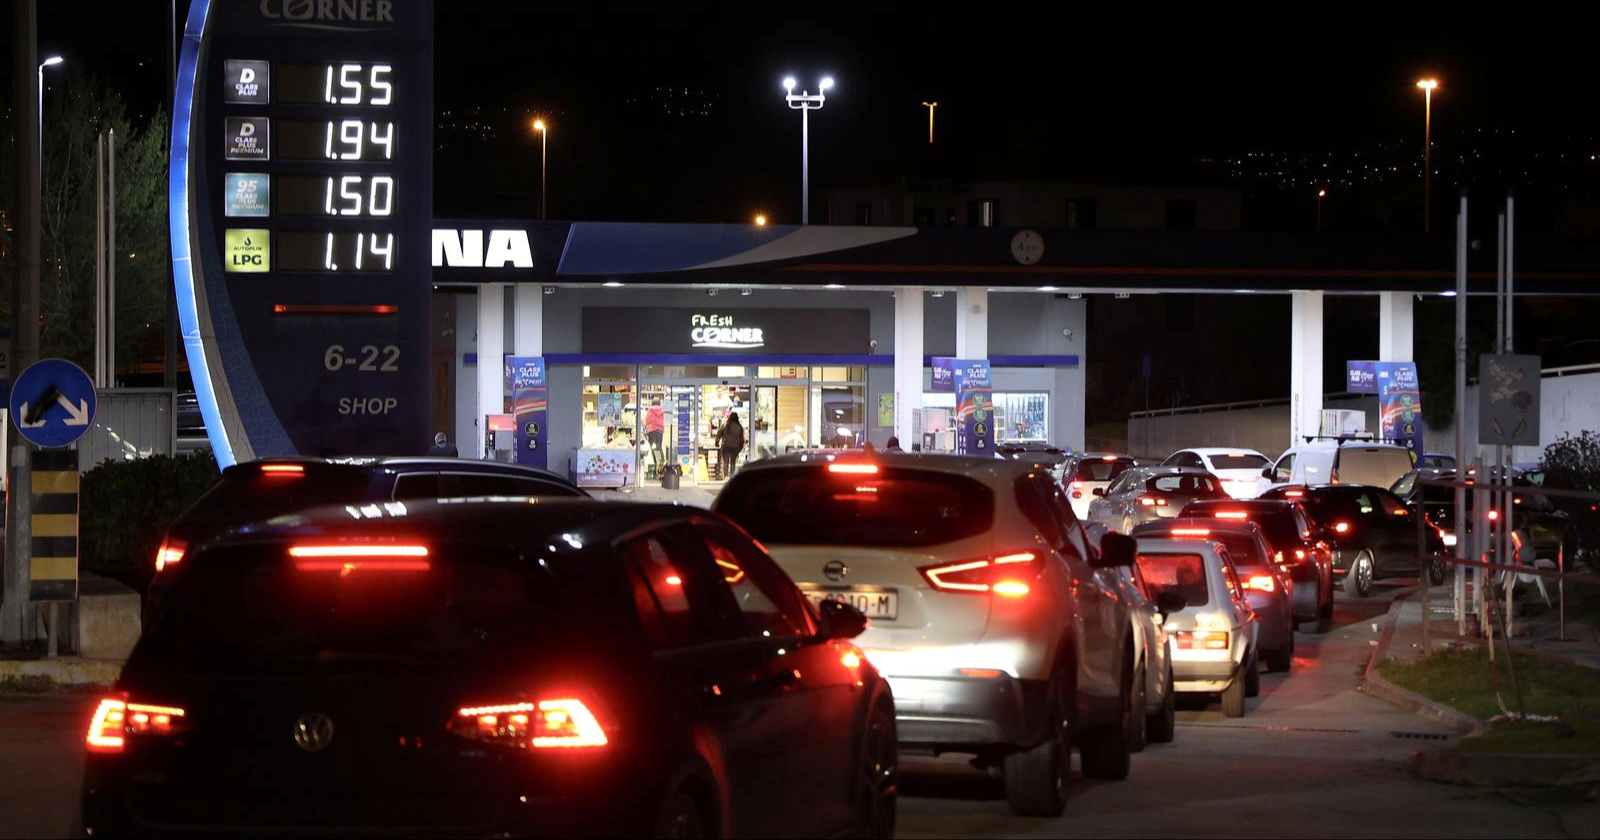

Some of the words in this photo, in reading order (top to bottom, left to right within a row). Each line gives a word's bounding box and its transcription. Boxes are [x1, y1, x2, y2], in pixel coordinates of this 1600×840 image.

[259, 0, 394, 22] CORNER
[240, 68, 255, 83] D
[325, 64, 392, 105] 1.55
[240, 123, 255, 136] D
[325, 120, 393, 160] 1.94
[237, 180, 257, 193] 95
[325, 176, 393, 216] 1.50
[325, 232, 393, 271] 1.14
[431, 229, 533, 268] NA
[233, 254, 262, 266] LPG
[691, 314, 733, 327] FRESH
[691, 327, 764, 343] CORNER
[324, 344, 401, 372] 6-22
[338, 397, 398, 414] SHOP
